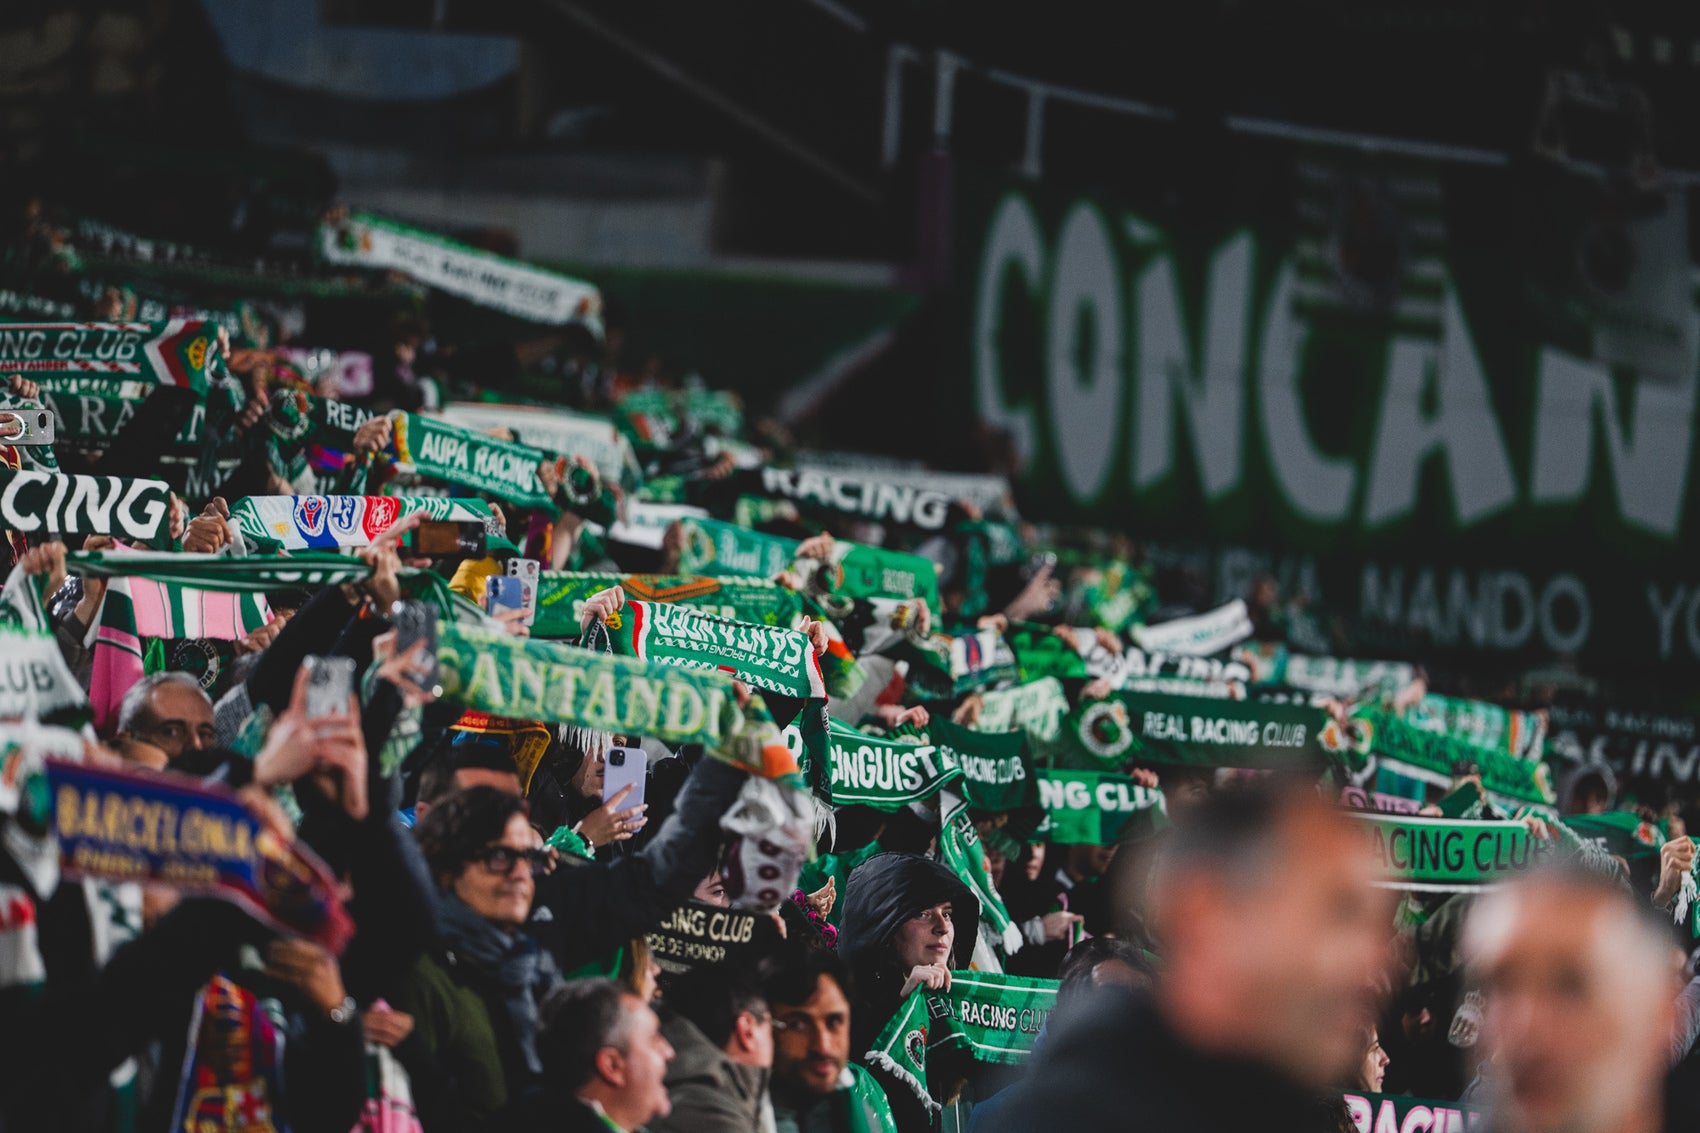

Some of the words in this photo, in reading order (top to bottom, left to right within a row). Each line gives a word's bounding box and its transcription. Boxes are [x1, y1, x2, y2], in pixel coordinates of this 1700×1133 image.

[53, 331, 141, 360] CLUB
[325, 398, 374, 431] REA
[420, 431, 469, 474] AUPA
[0, 469, 171, 540] CING
[761, 466, 949, 531] RACING
[654, 602, 808, 665] SANTANDER
[707, 643, 747, 665] RACING
[1143, 711, 1187, 742] REAL
[1190, 716, 1259, 746] RACING
[1262, 721, 1307, 748] CLUB
[960, 753, 997, 785] RACING
[997, 755, 1026, 785] CLUB
[1095, 782, 1167, 816] CLU
[708, 911, 755, 944] CLUB
[961, 1000, 1017, 1032] RACING
[1019, 1008, 1050, 1033] CLU
